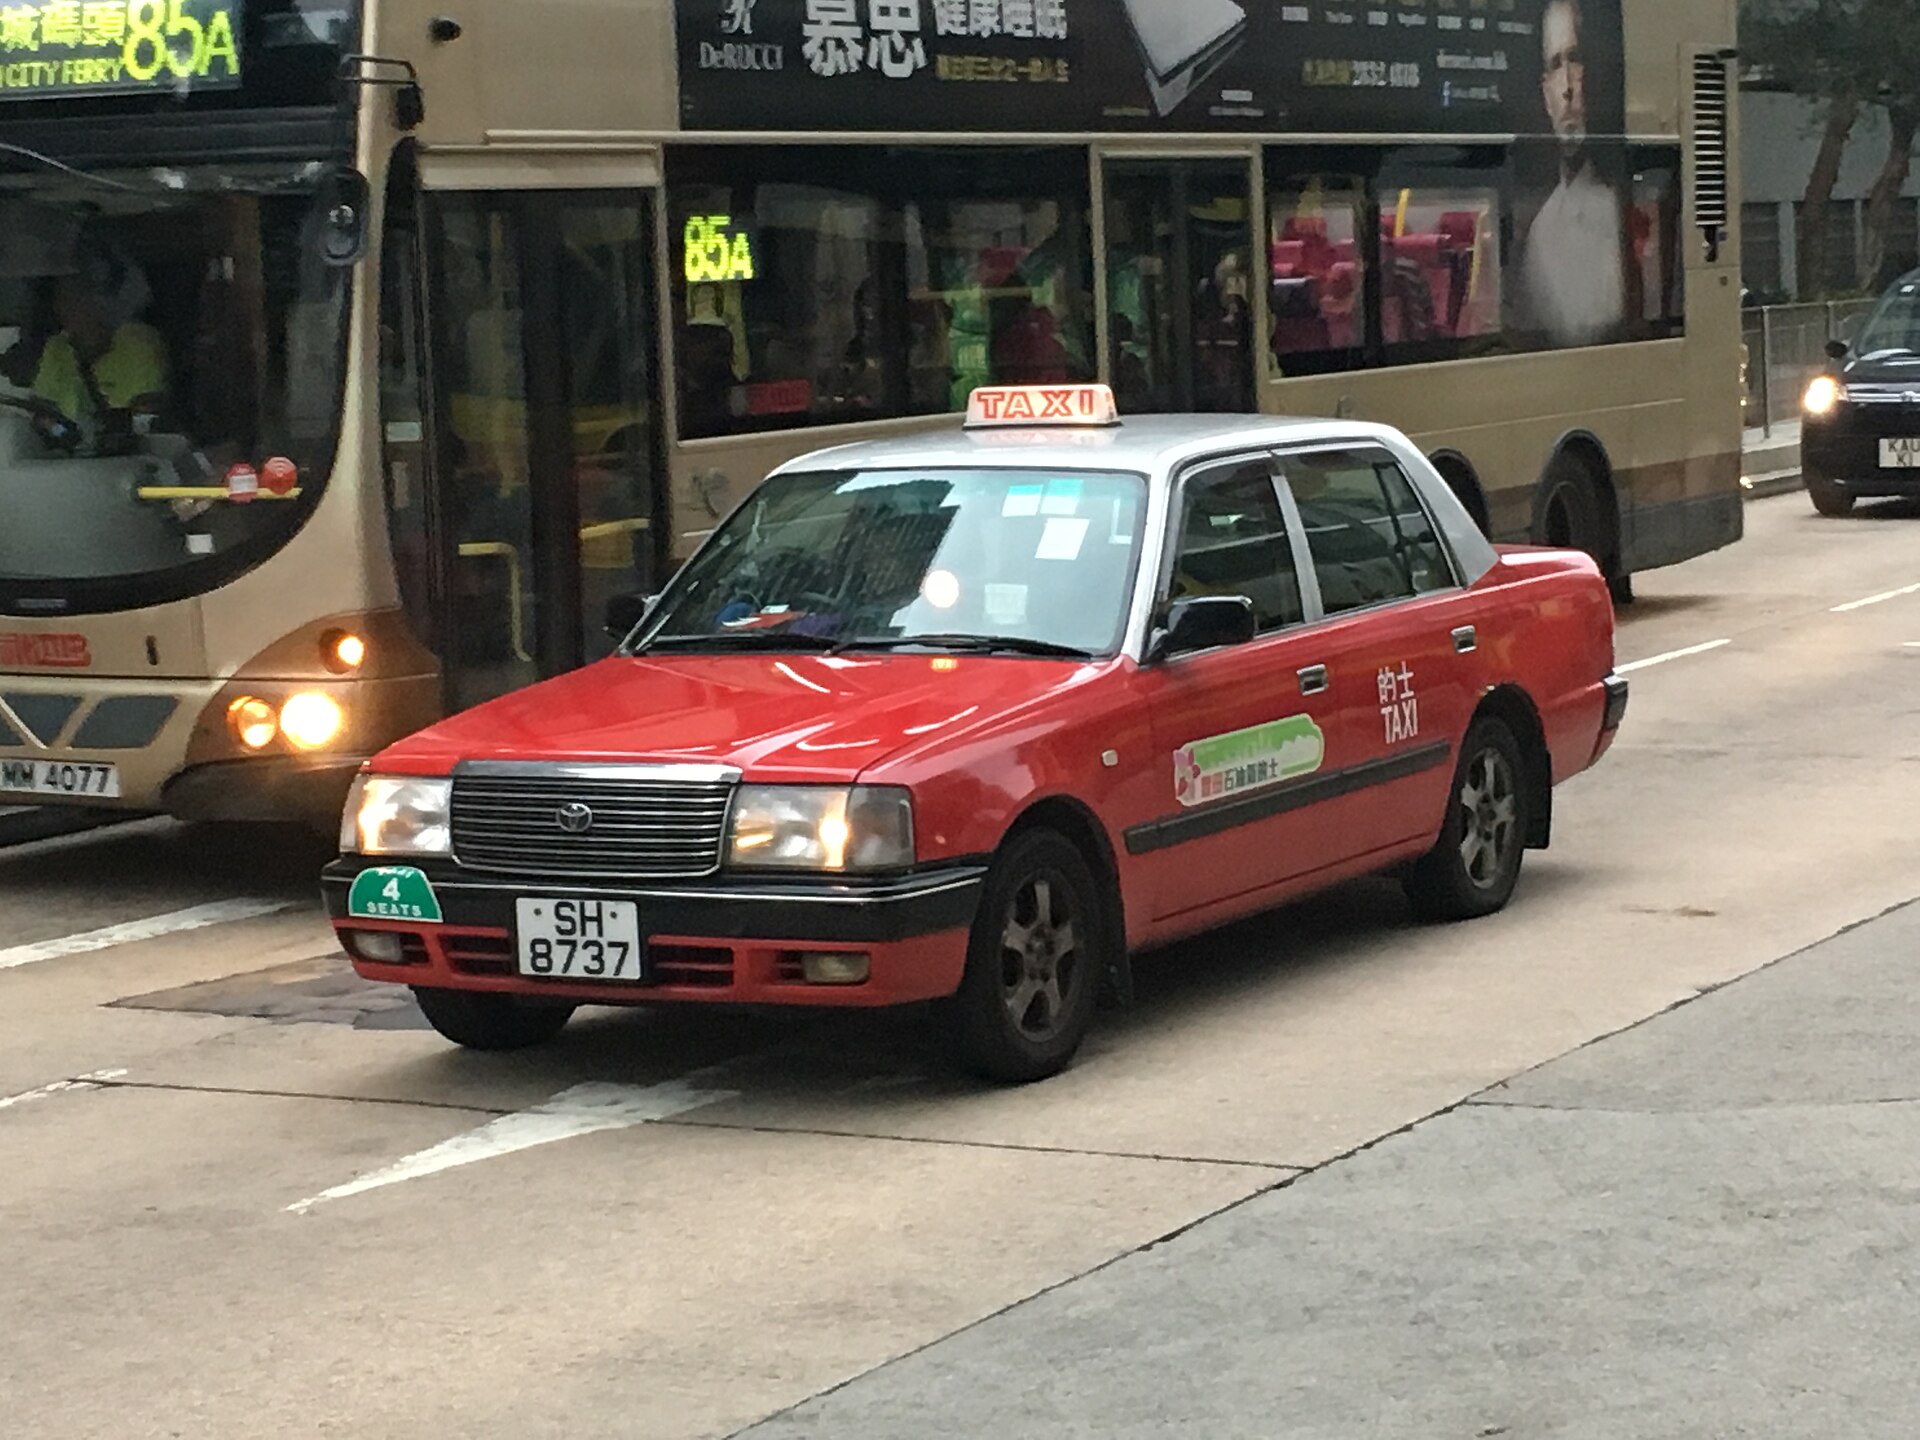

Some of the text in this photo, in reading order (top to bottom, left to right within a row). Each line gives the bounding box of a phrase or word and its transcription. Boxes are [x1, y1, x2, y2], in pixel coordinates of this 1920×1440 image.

[124, 0, 240, 80] 85A
[684, 215, 753, 281] 85A
[976, 388, 1094, 419] TAXI
[1377, 660, 1415, 704] 的士
[1381, 698, 1418, 744] TAXI
[42, 764, 111, 794] 4077
[381, 876, 402, 902] 4
[366, 901, 422, 917] SEATS
[553, 901, 604, 937] SH
[529, 938, 630, 976] 8737
